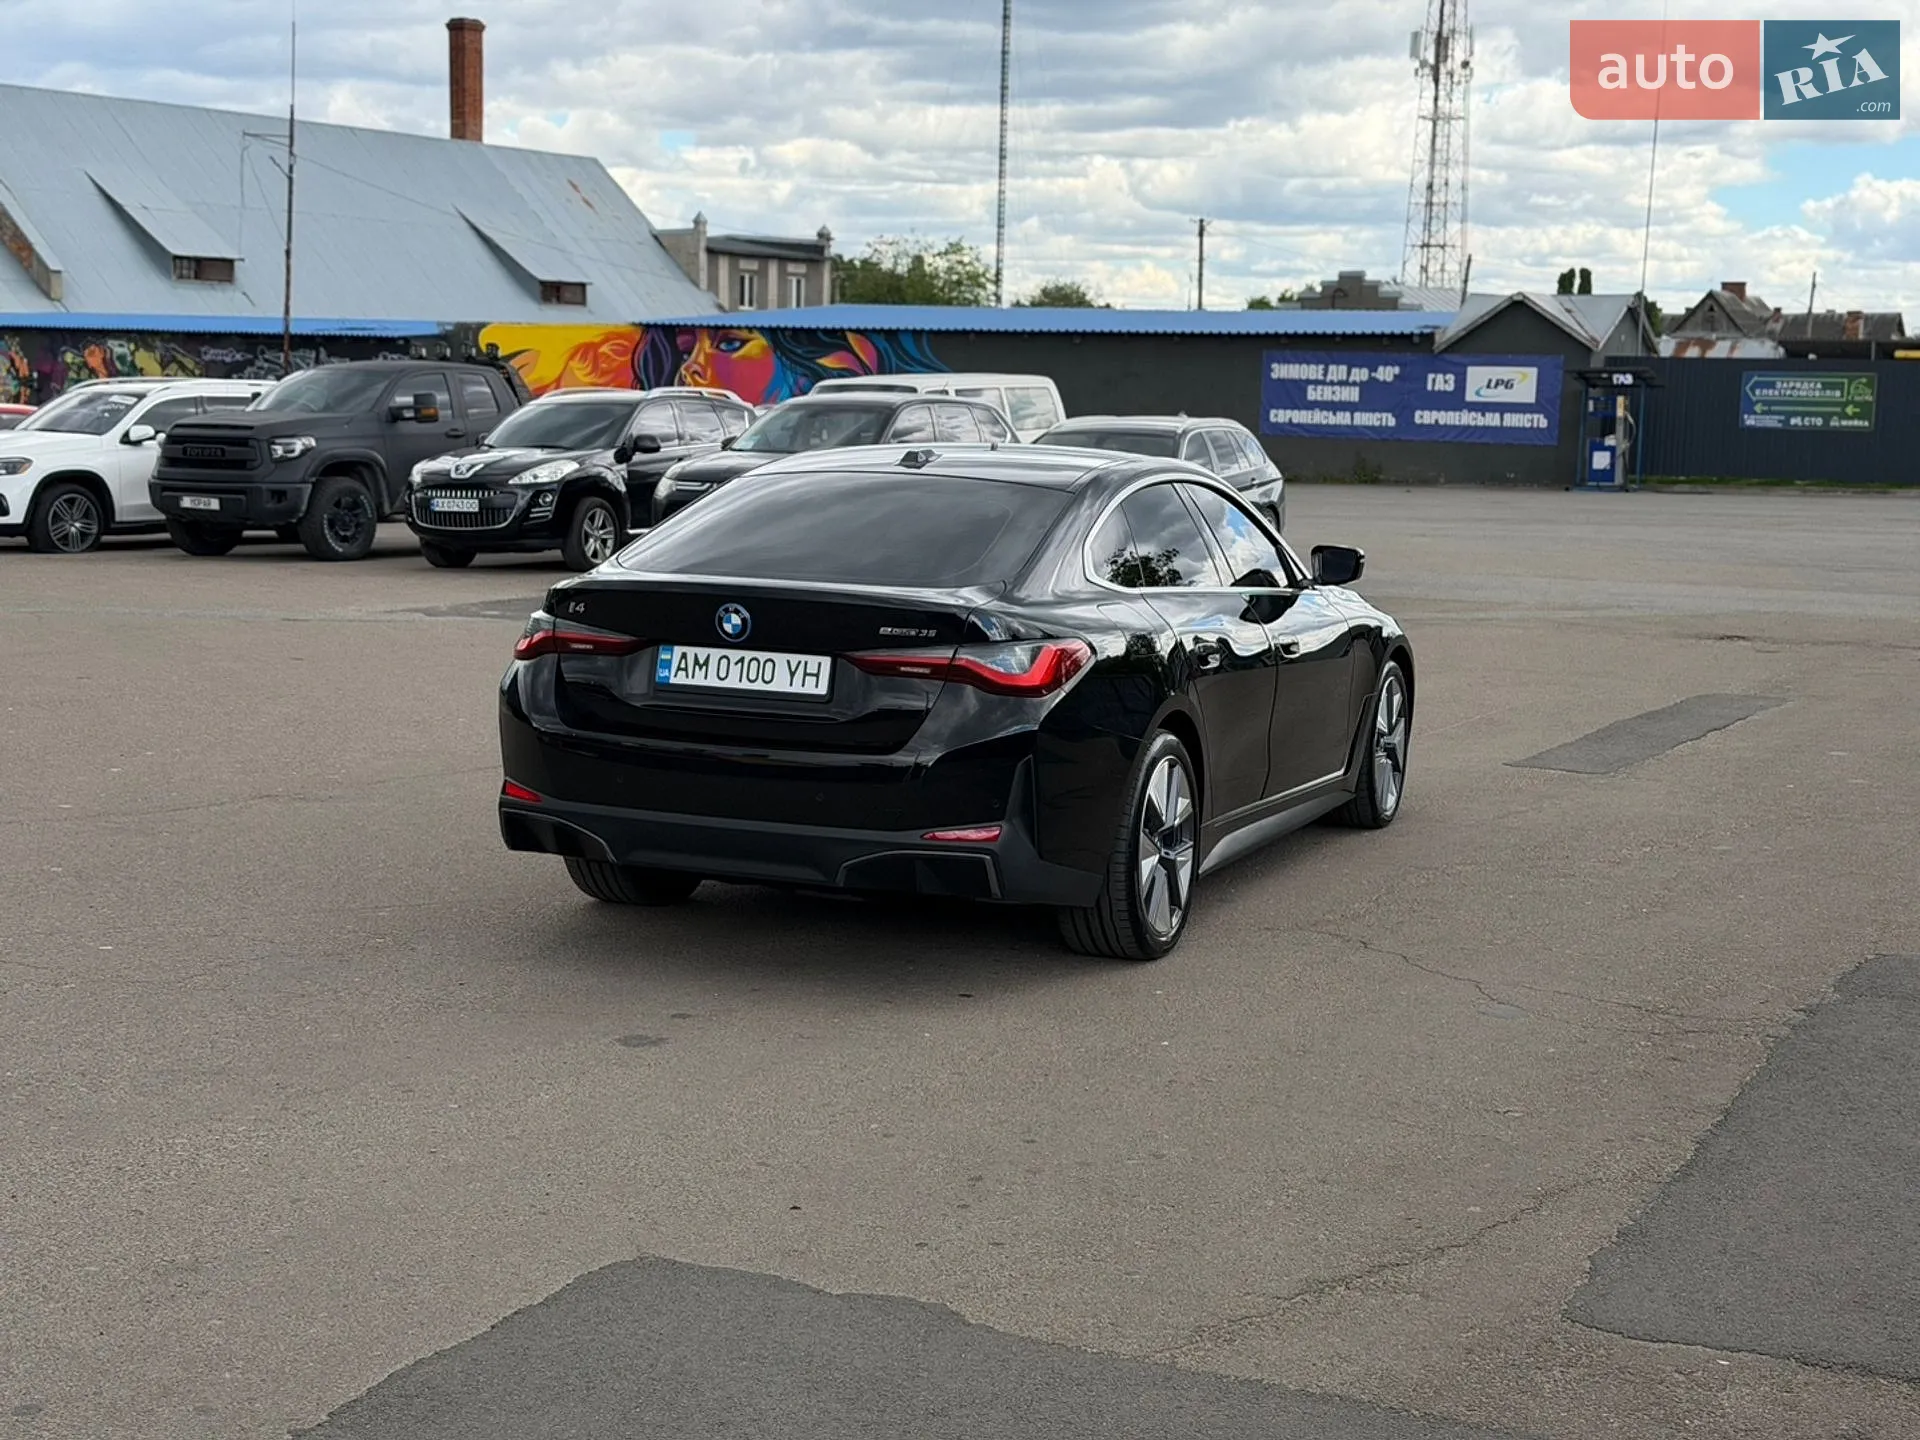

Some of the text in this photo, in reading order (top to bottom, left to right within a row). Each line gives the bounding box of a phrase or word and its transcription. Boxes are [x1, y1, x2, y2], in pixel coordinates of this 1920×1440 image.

[1270, 363, 1326, 380] ЗИМОВЕ
[1326, 364, 1348, 383] ДП
[1348, 367, 1369, 383] до
[1426, 373, 1456, 391] ГАЗ
[1612, 373, 1634, 385] ГАЗ
[1306, 384, 1360, 402] БЕНЗИН
[1486, 378, 1516, 390] LPG
[1269, 408, 1396, 427] ЄВРОПЕЙСЬКА ЯКІСТЬ
[1414, 408, 1548, 428] ЄВРОПЕЙСЬКА ЯКІСТЬ
[673, 651, 822, 689] AM 0100 YH
